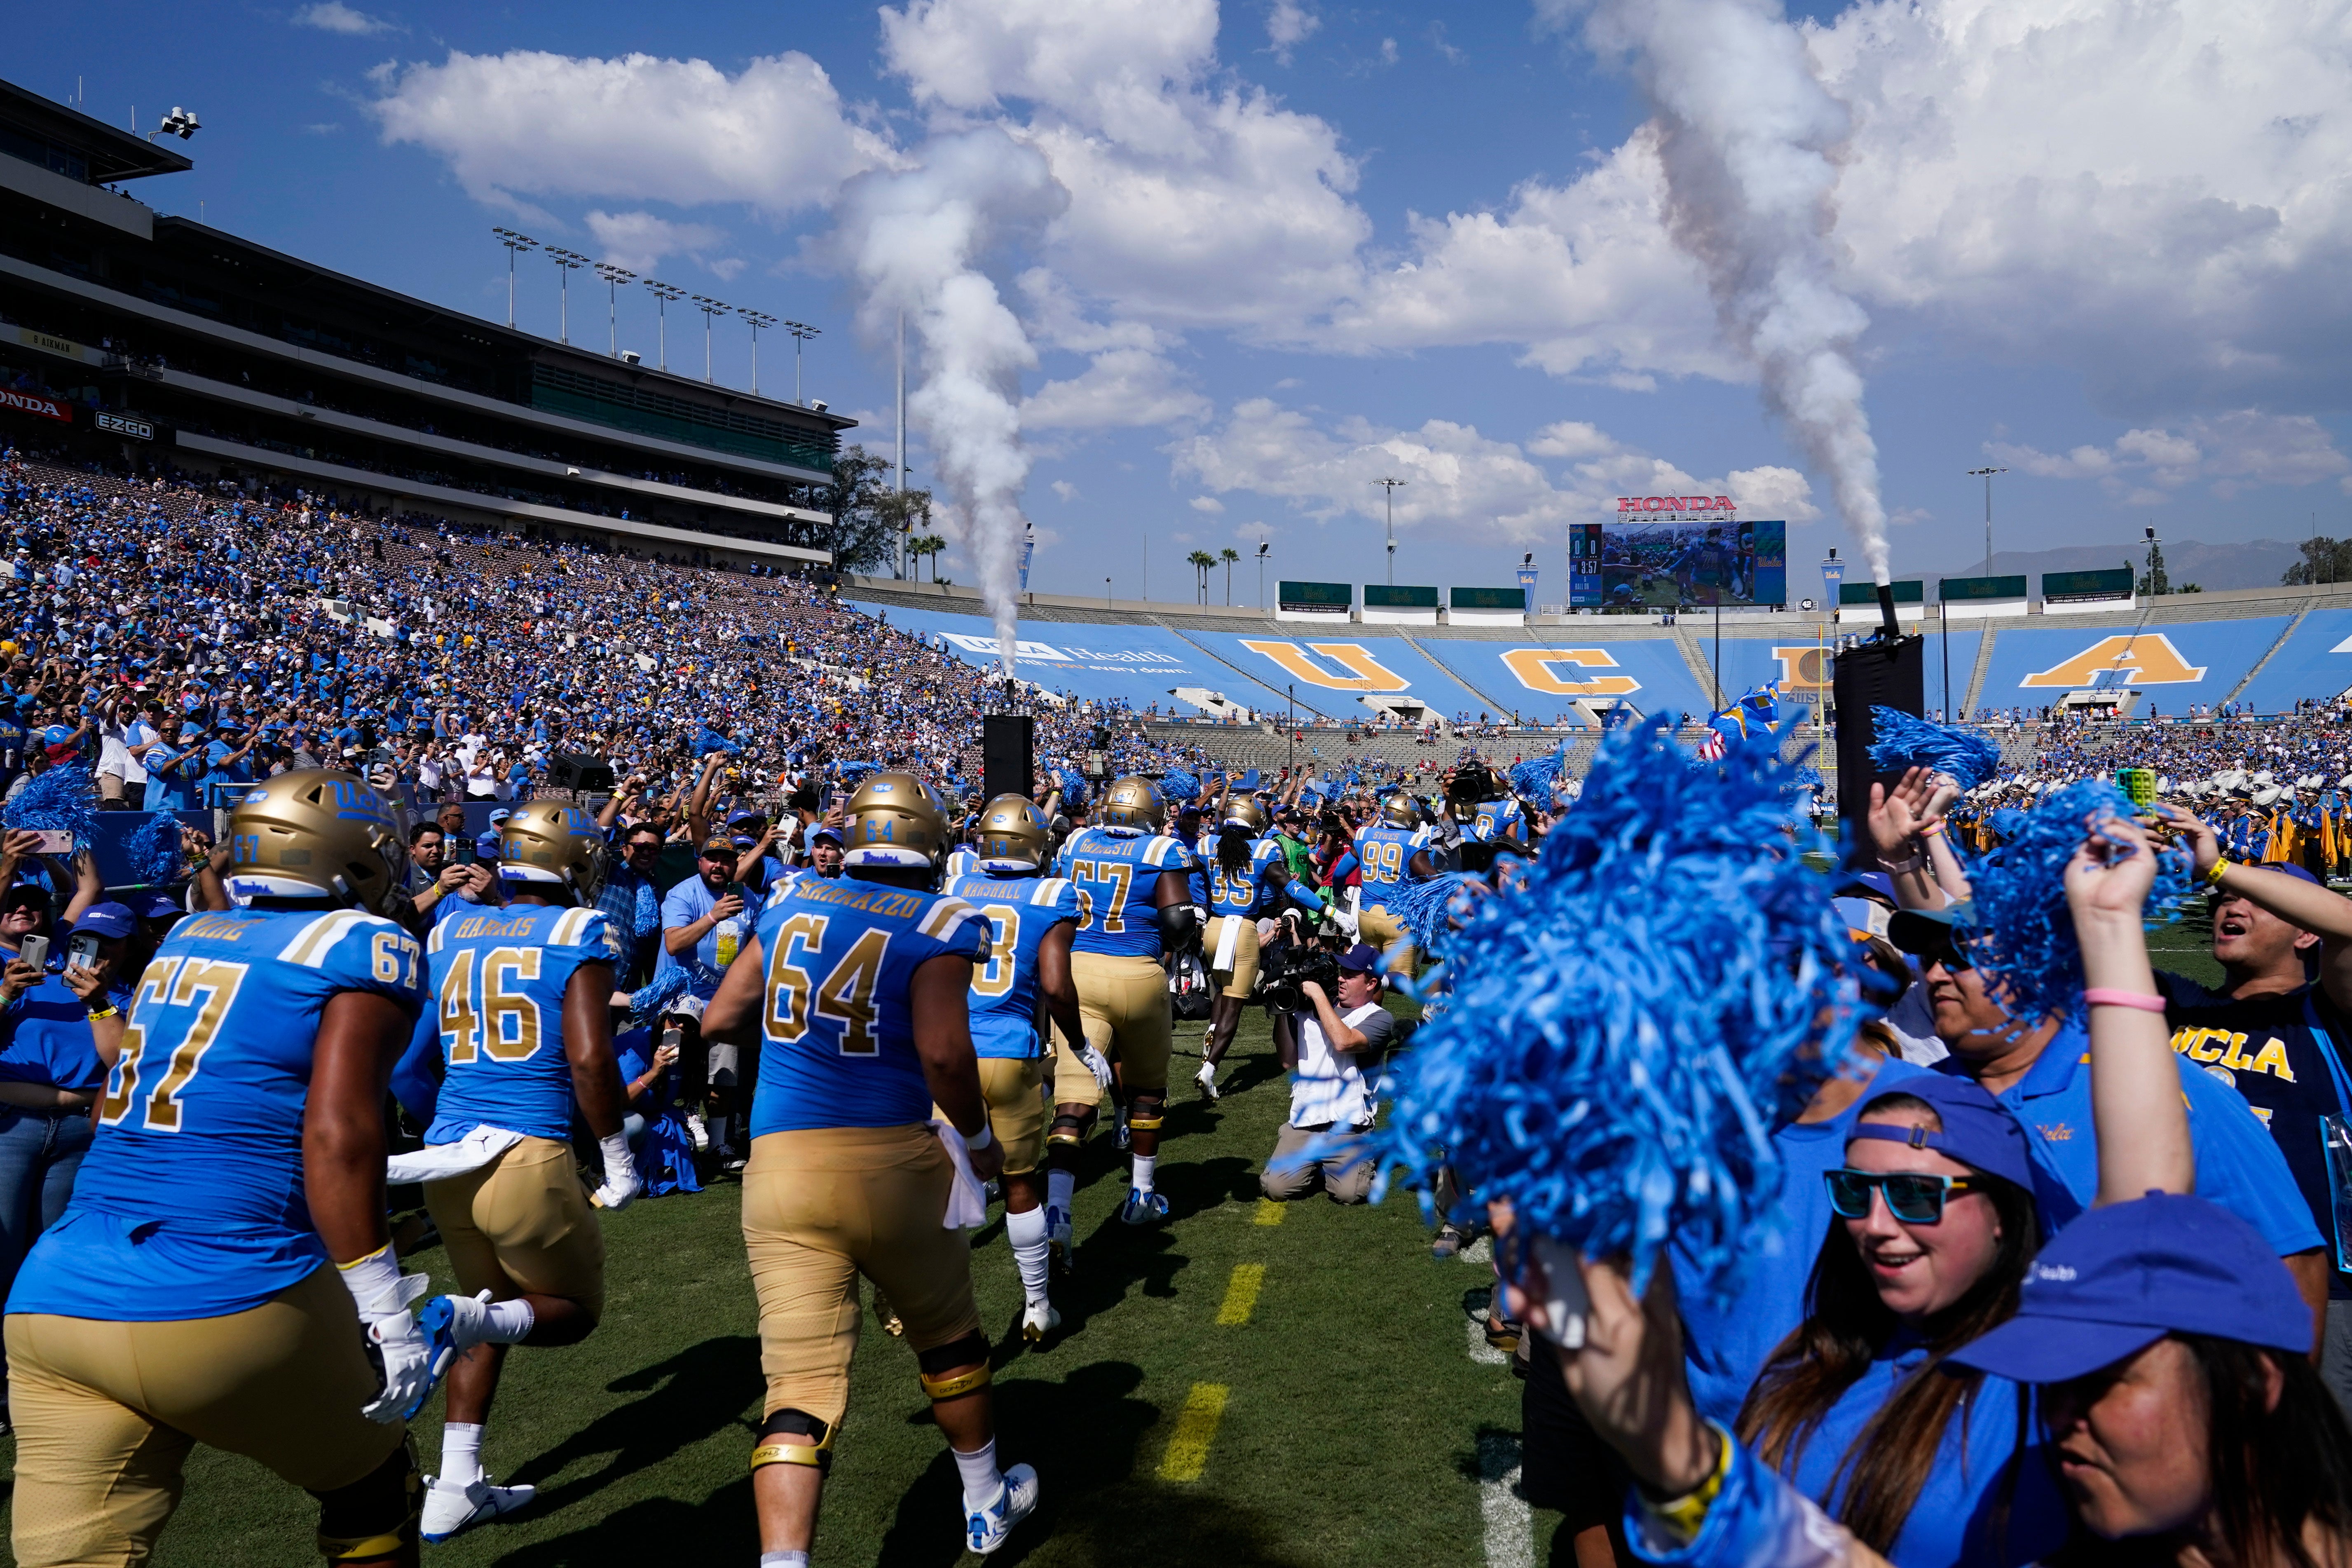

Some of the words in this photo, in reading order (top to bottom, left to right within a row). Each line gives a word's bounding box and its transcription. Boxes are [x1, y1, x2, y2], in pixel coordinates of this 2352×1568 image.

[42, 338, 70, 352] AIKMAN
[1617, 496, 1737, 512] HONDA
[1581, 561, 1597, 574] 3:57
[1757, 556, 1782, 567] Ucla
[1015, 658, 1048, 666] ith
[1060, 647, 1183, 663] Health
[1479, 803, 1497, 814] BOBO
[1111, 811, 1126, 825] 57
[867, 820, 893, 841] 64
[1373, 832, 1400, 841] SYKES
[235, 834, 259, 863] 67
[503, 840, 521, 859] 46
[709, 840, 719, 848] Rip
[721, 841, 733, 851] City
[991, 840, 1007, 855] 18
[862, 851, 901, 863] Bruins
[1362, 841, 1403, 884] 99
[988, 862, 1013, 870] Bruins
[961, 882, 1021, 899] MARSHALL
[1211, 858, 1254, 907] 35
[455, 917, 537, 939] HARRIS
[371, 932, 420, 989] 67
[763, 913, 892, 1057] 64
[440, 947, 543, 1065] 46
[687, 1000, 696, 1010] B
[100, 956, 249, 1132] 67
